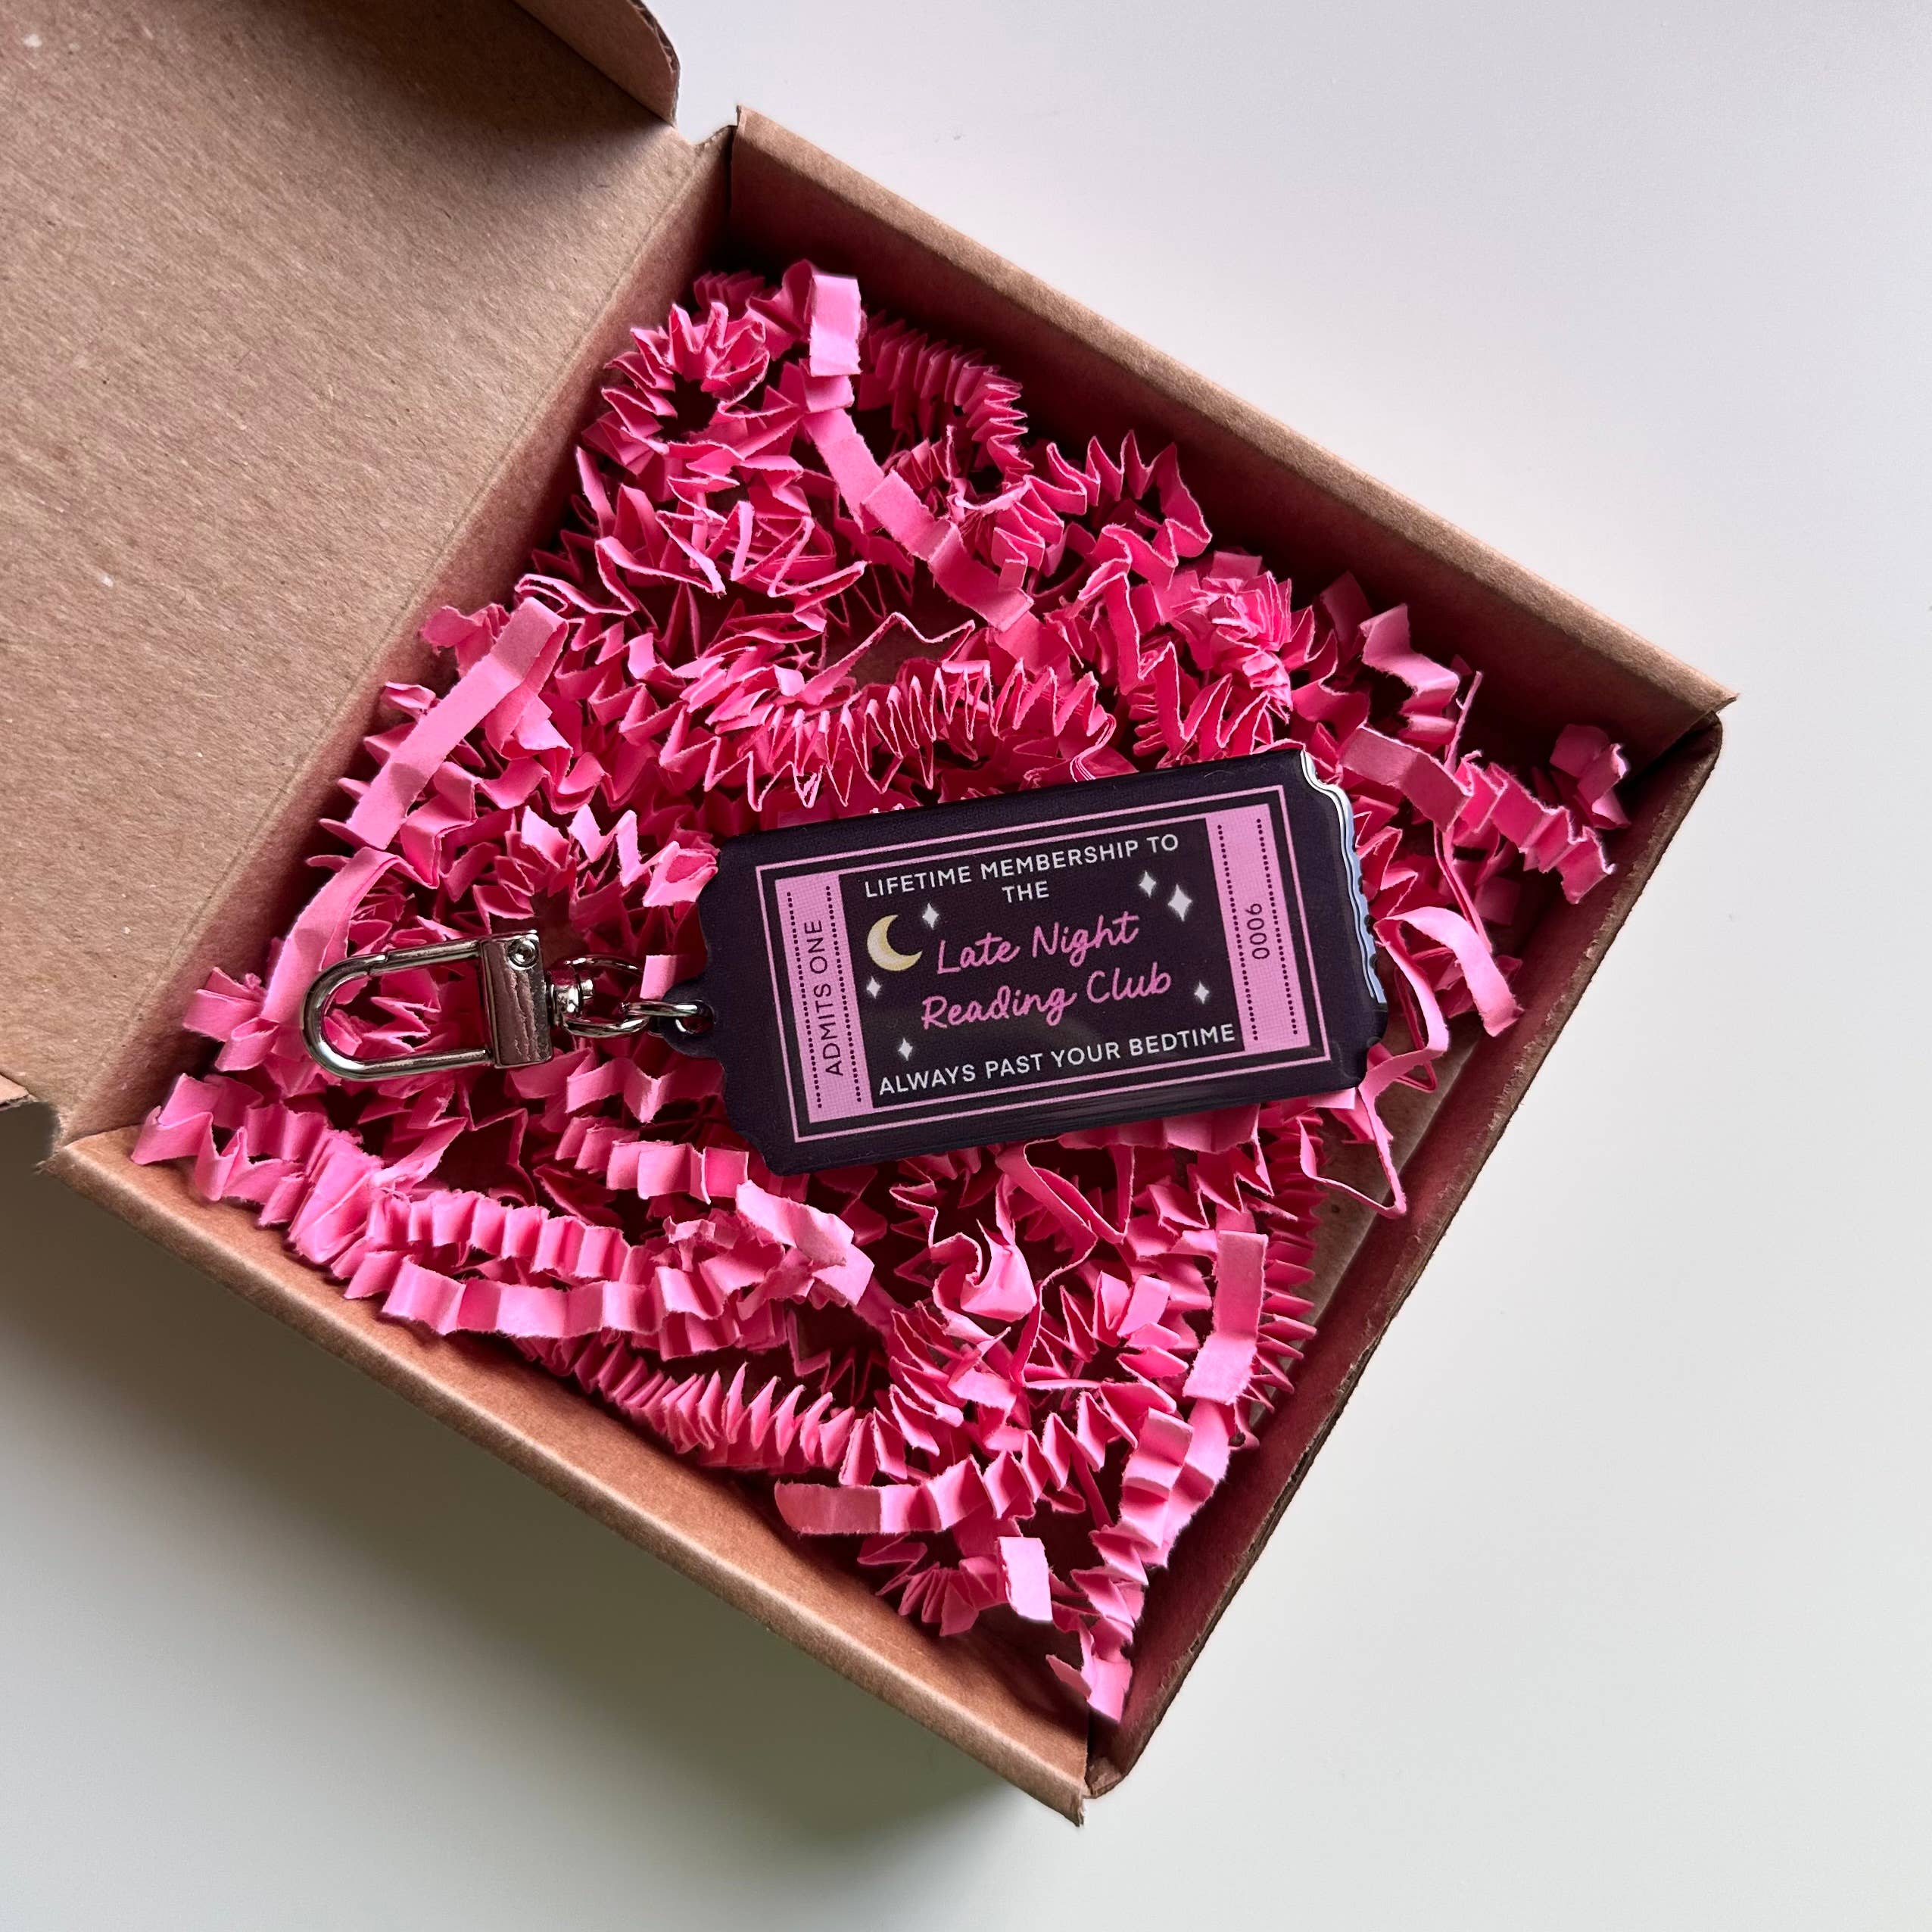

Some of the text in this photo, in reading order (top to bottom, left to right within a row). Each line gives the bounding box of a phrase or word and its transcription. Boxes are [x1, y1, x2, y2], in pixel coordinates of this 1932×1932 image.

[865, 834, 1178, 898] LIFETIME MEMBERSHIP TO
[1002, 880, 1049, 902] THE
[937, 911, 1139, 974] Late Night
[1245, 902, 1270, 960] 0006
[804, 921, 844, 1077] ADMITS ONE
[921, 961, 1171, 1027] Reading Club
[880, 1024, 1236, 1096] ALWAYS PAST YOUR BEDTIME
